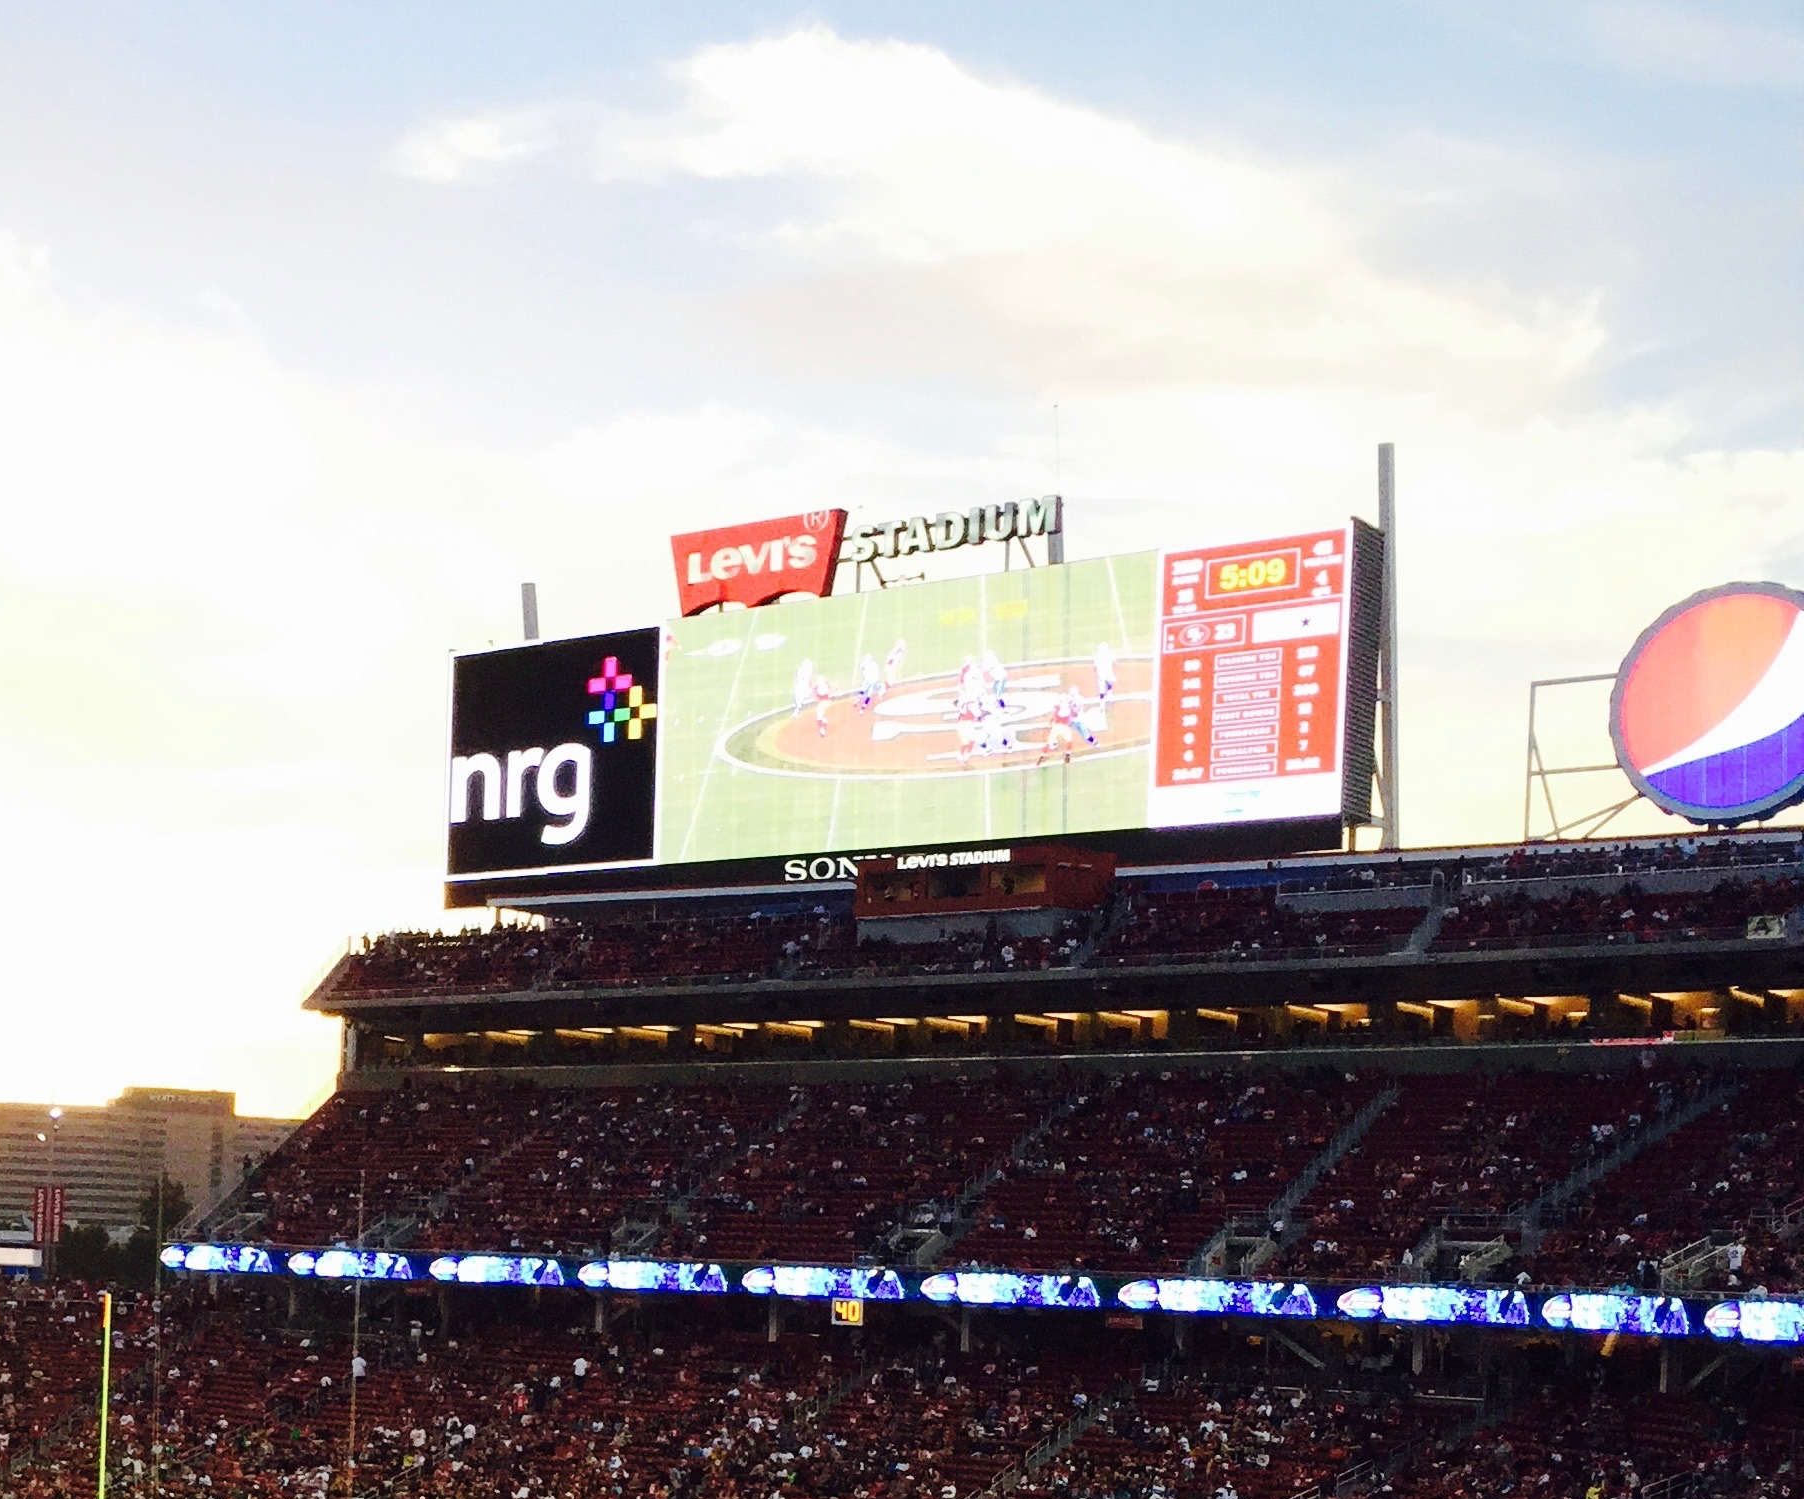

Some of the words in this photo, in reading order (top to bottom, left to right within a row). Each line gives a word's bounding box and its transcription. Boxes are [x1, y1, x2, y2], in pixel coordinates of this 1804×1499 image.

[850, 495, 1062, 565] STADIUM
[1219, 557, 1287, 590] 5:09
[450, 740, 591, 845] nrg
[784, 856, 859, 883] SON
[949, 847, 1012, 866] STADIUM
[834, 1302, 861, 1322] 40
